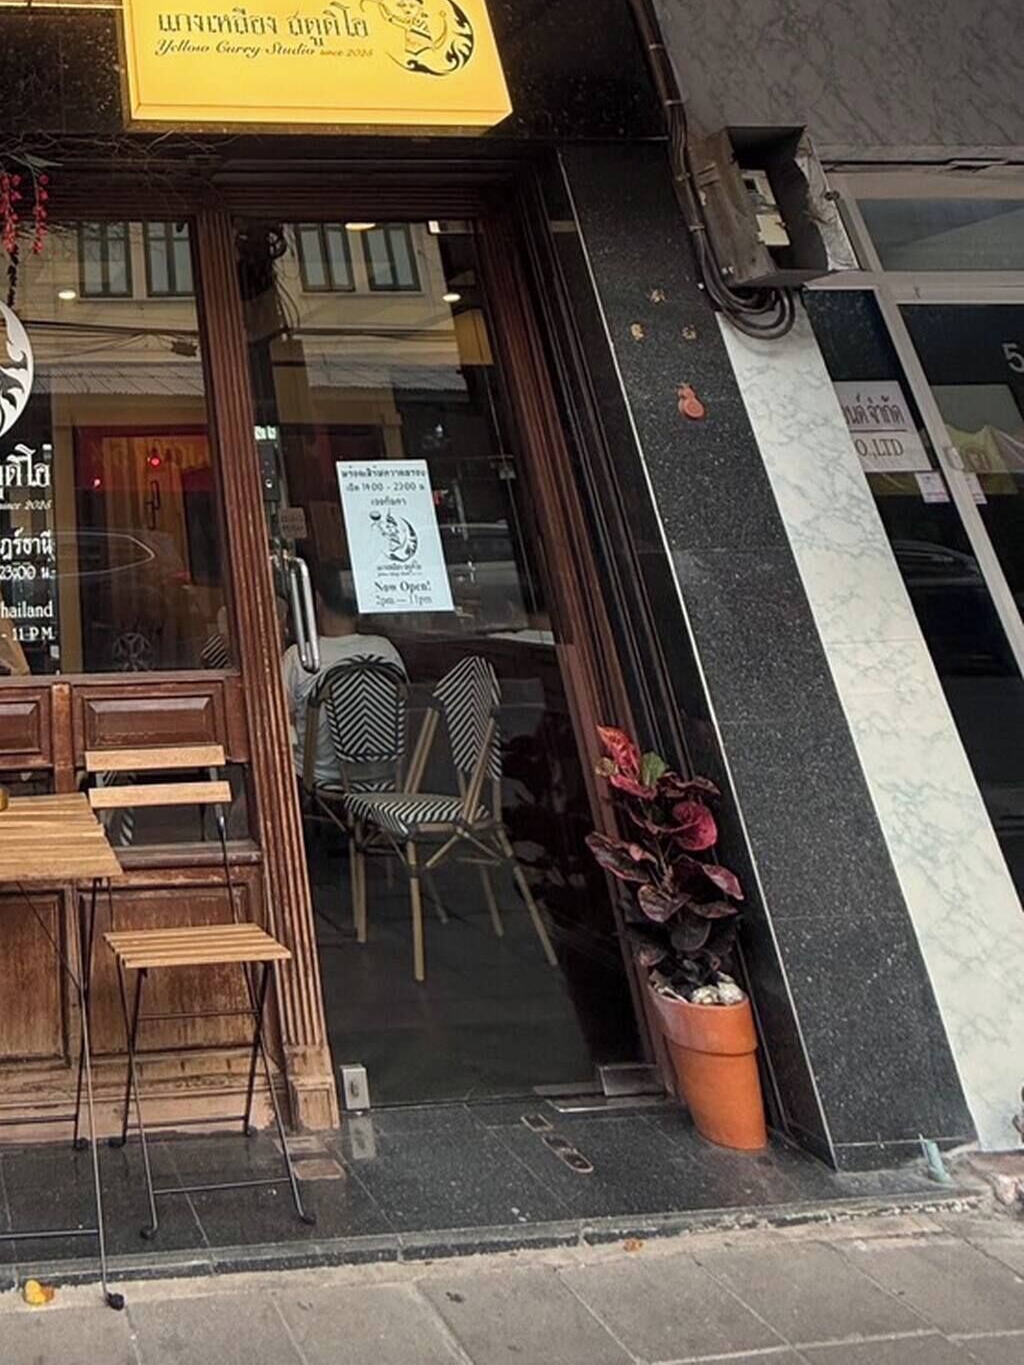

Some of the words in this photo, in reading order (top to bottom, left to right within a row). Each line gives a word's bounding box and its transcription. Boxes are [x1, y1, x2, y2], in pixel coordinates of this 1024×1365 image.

[157, 7, 278, 35] แกงเหลือง
[286, 1, 369, 47] สตูดิโอ
[155, 38, 210, 56] Yellow
[215, 40, 261, 58] Curry
[265, 40, 316, 56] Studio
[855, 439, 904, 459] O.,LTD
